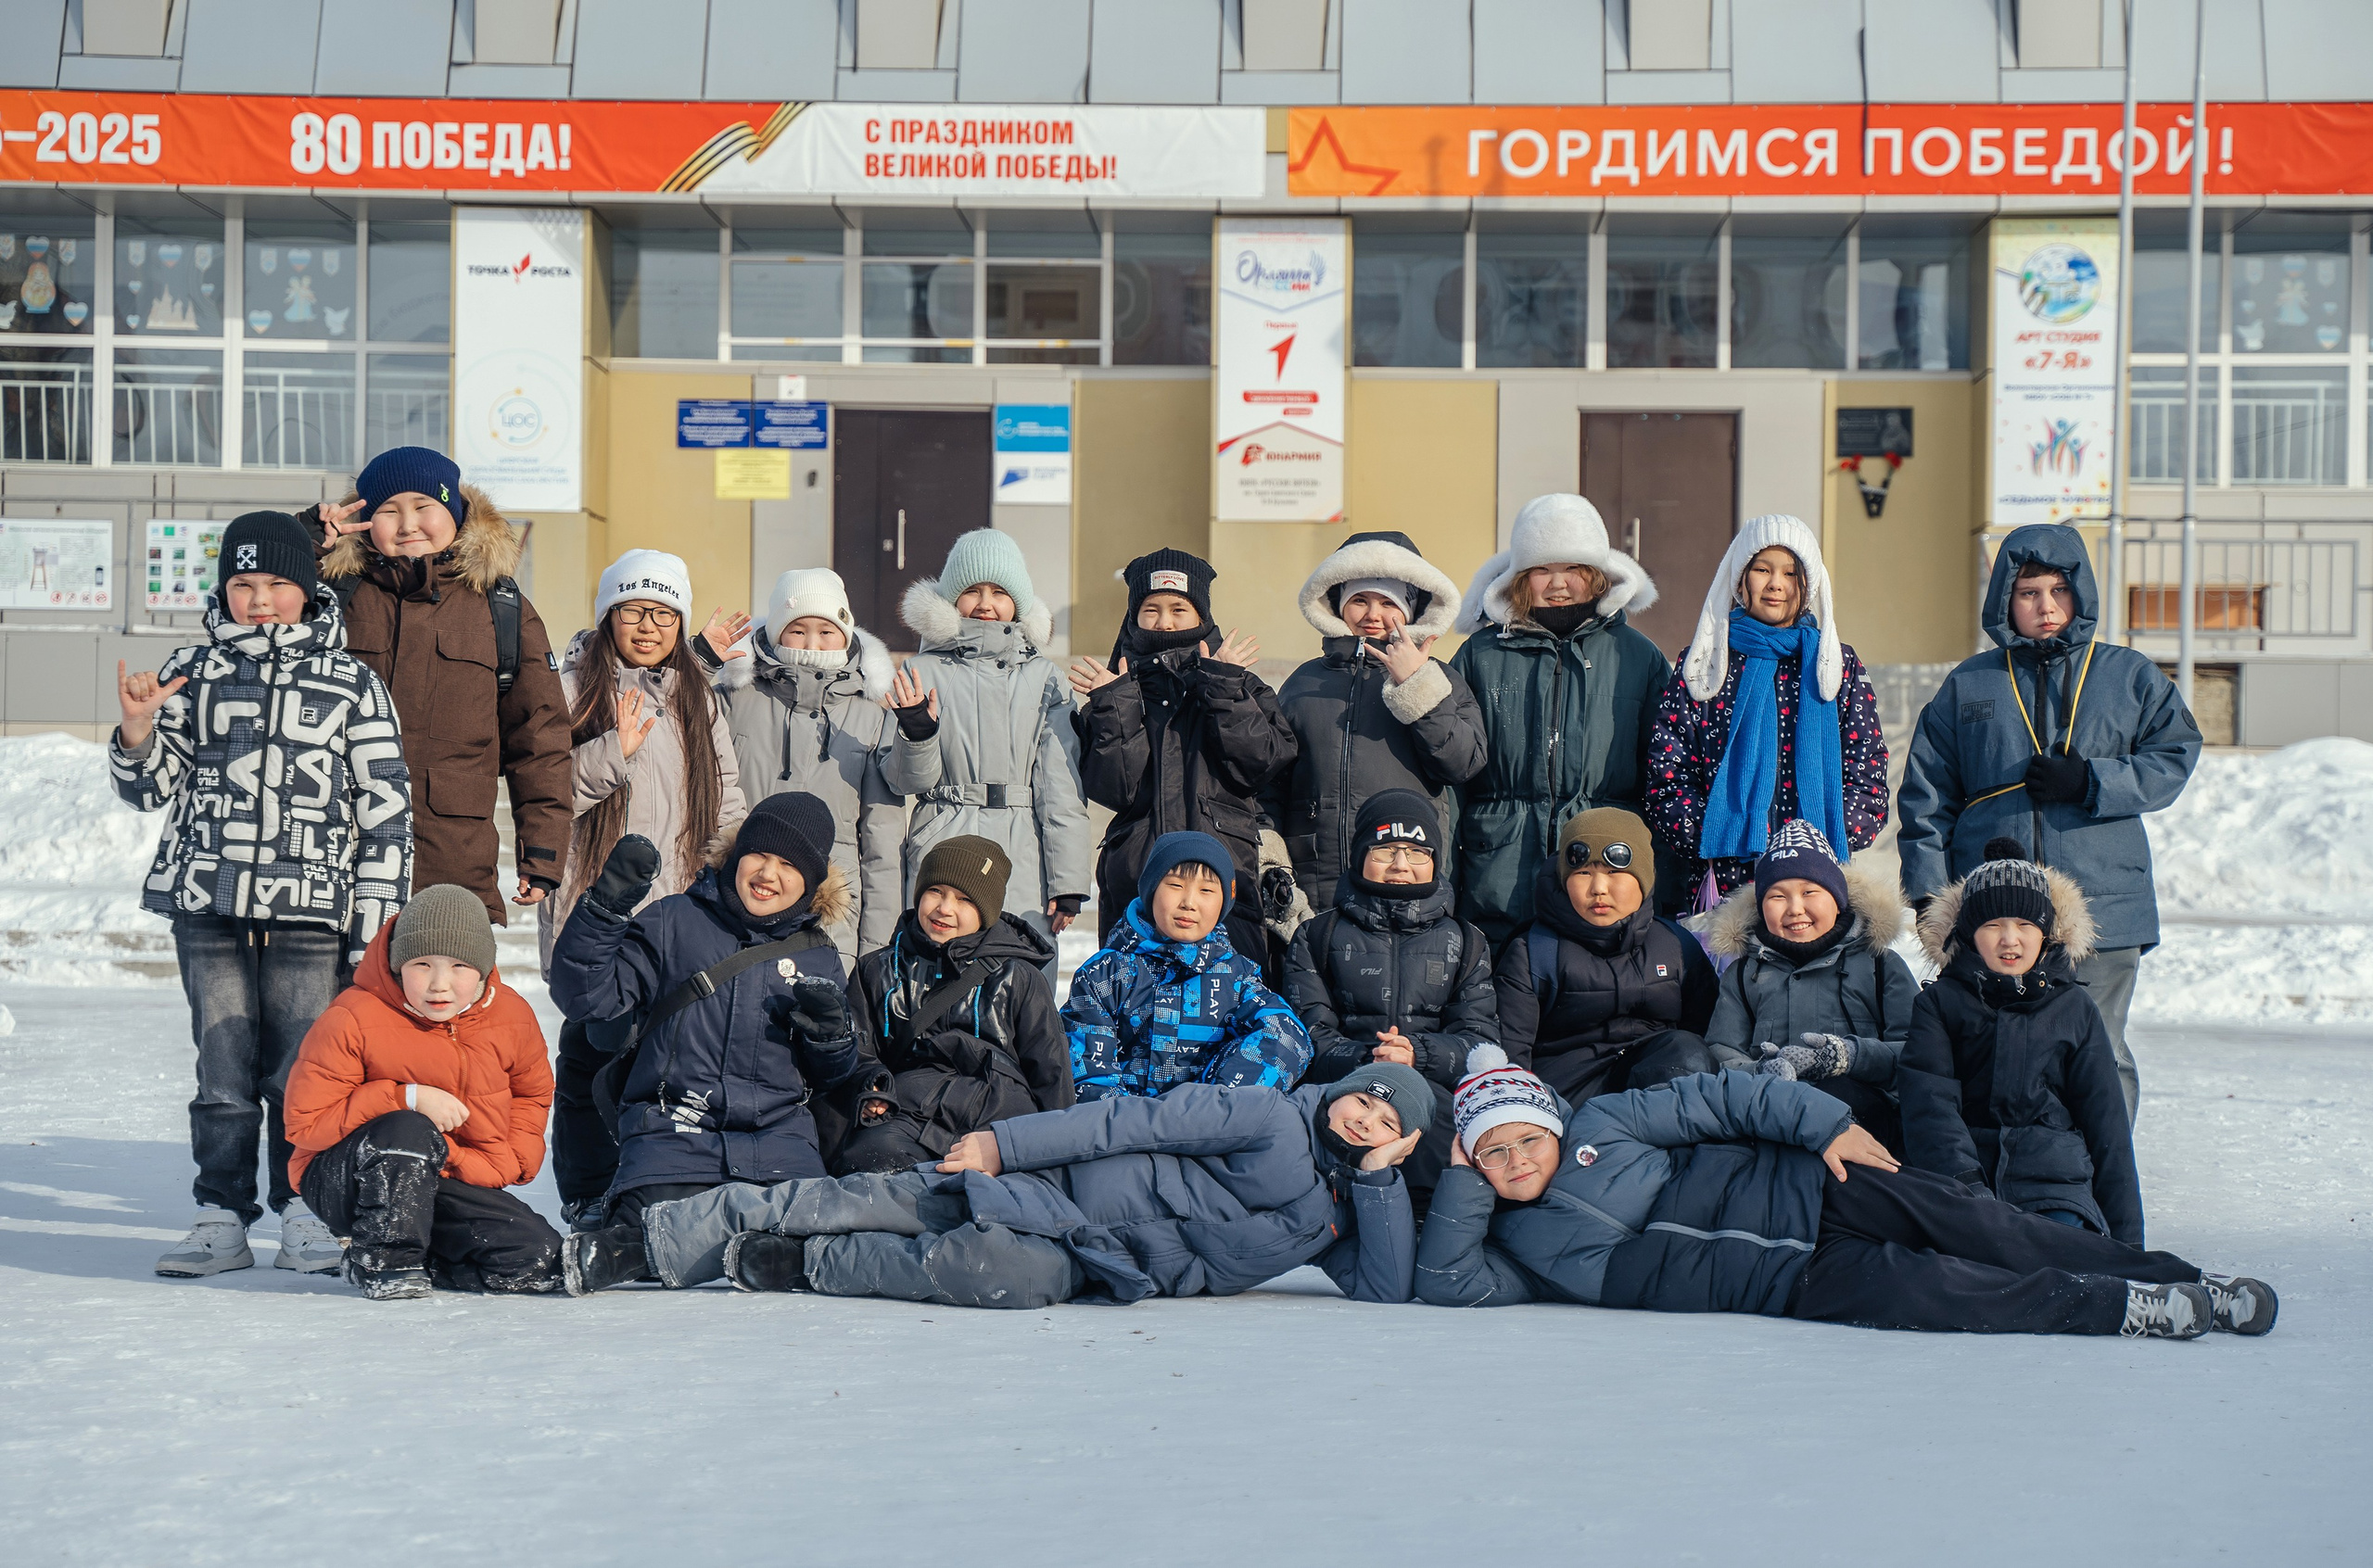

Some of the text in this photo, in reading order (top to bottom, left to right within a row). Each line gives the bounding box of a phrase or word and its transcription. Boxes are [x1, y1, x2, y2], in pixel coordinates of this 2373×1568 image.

[865, 119, 1074, 148] С ПРАЗДНИКОМ
[290, 112, 572, 178] 80 ПОБЕДА!
[1466, 116, 2235, 185] ГОРДИМСЯ ПОБЕДОЙ!
[865, 149, 1118, 183] ВЕЛИКОЙ ПОБЕДЫ!
[468, 265, 571, 277] ТОЧКА РОСТА
[2015, 330, 2101, 345] АРТ СТУДИЯ
[501, 413, 537, 428] ЦОС
[618, 577, 679, 600] Los Angeles
[281, 647, 304, 658] FILA
[193, 662, 203, 678] FILA
[1964, 702, 1993, 712] ATTITUDE
[197, 767, 220, 777] FILA
[286, 765, 295, 785] FILA
[283, 811, 291, 831] FILA
[1377, 822, 1426, 841] FILA
[327, 828, 339, 867] FILA
[1770, 848, 1799, 862] FILA
[1088, 955, 1112, 974] PLAY
[1210, 979, 1221, 1019] PLAY
[1426, 1004, 1441, 1013] FILA
